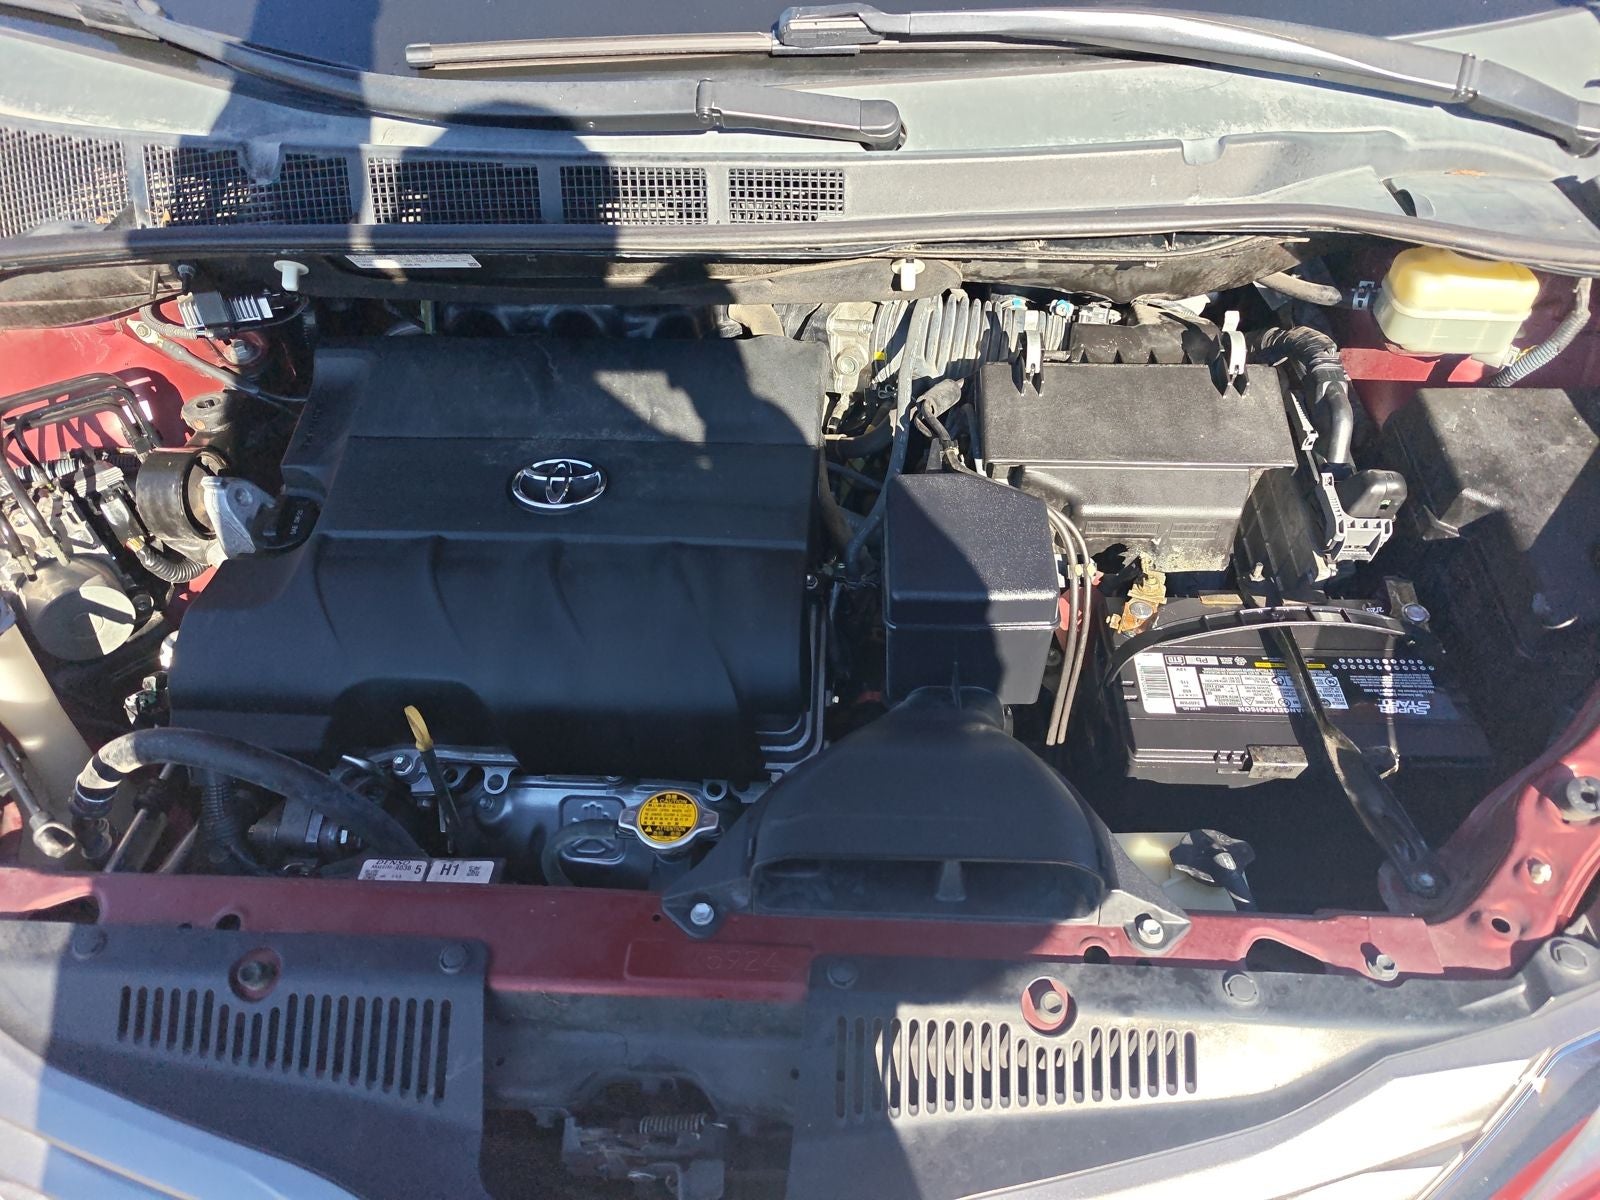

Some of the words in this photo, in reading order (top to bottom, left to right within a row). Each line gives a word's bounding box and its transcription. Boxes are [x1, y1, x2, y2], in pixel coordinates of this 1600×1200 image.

[1377, 700, 1430, 709] START
[1379, 706, 1429, 715] SUPER
[413, 864, 423, 875] 5
[439, 864, 460, 876] H1
